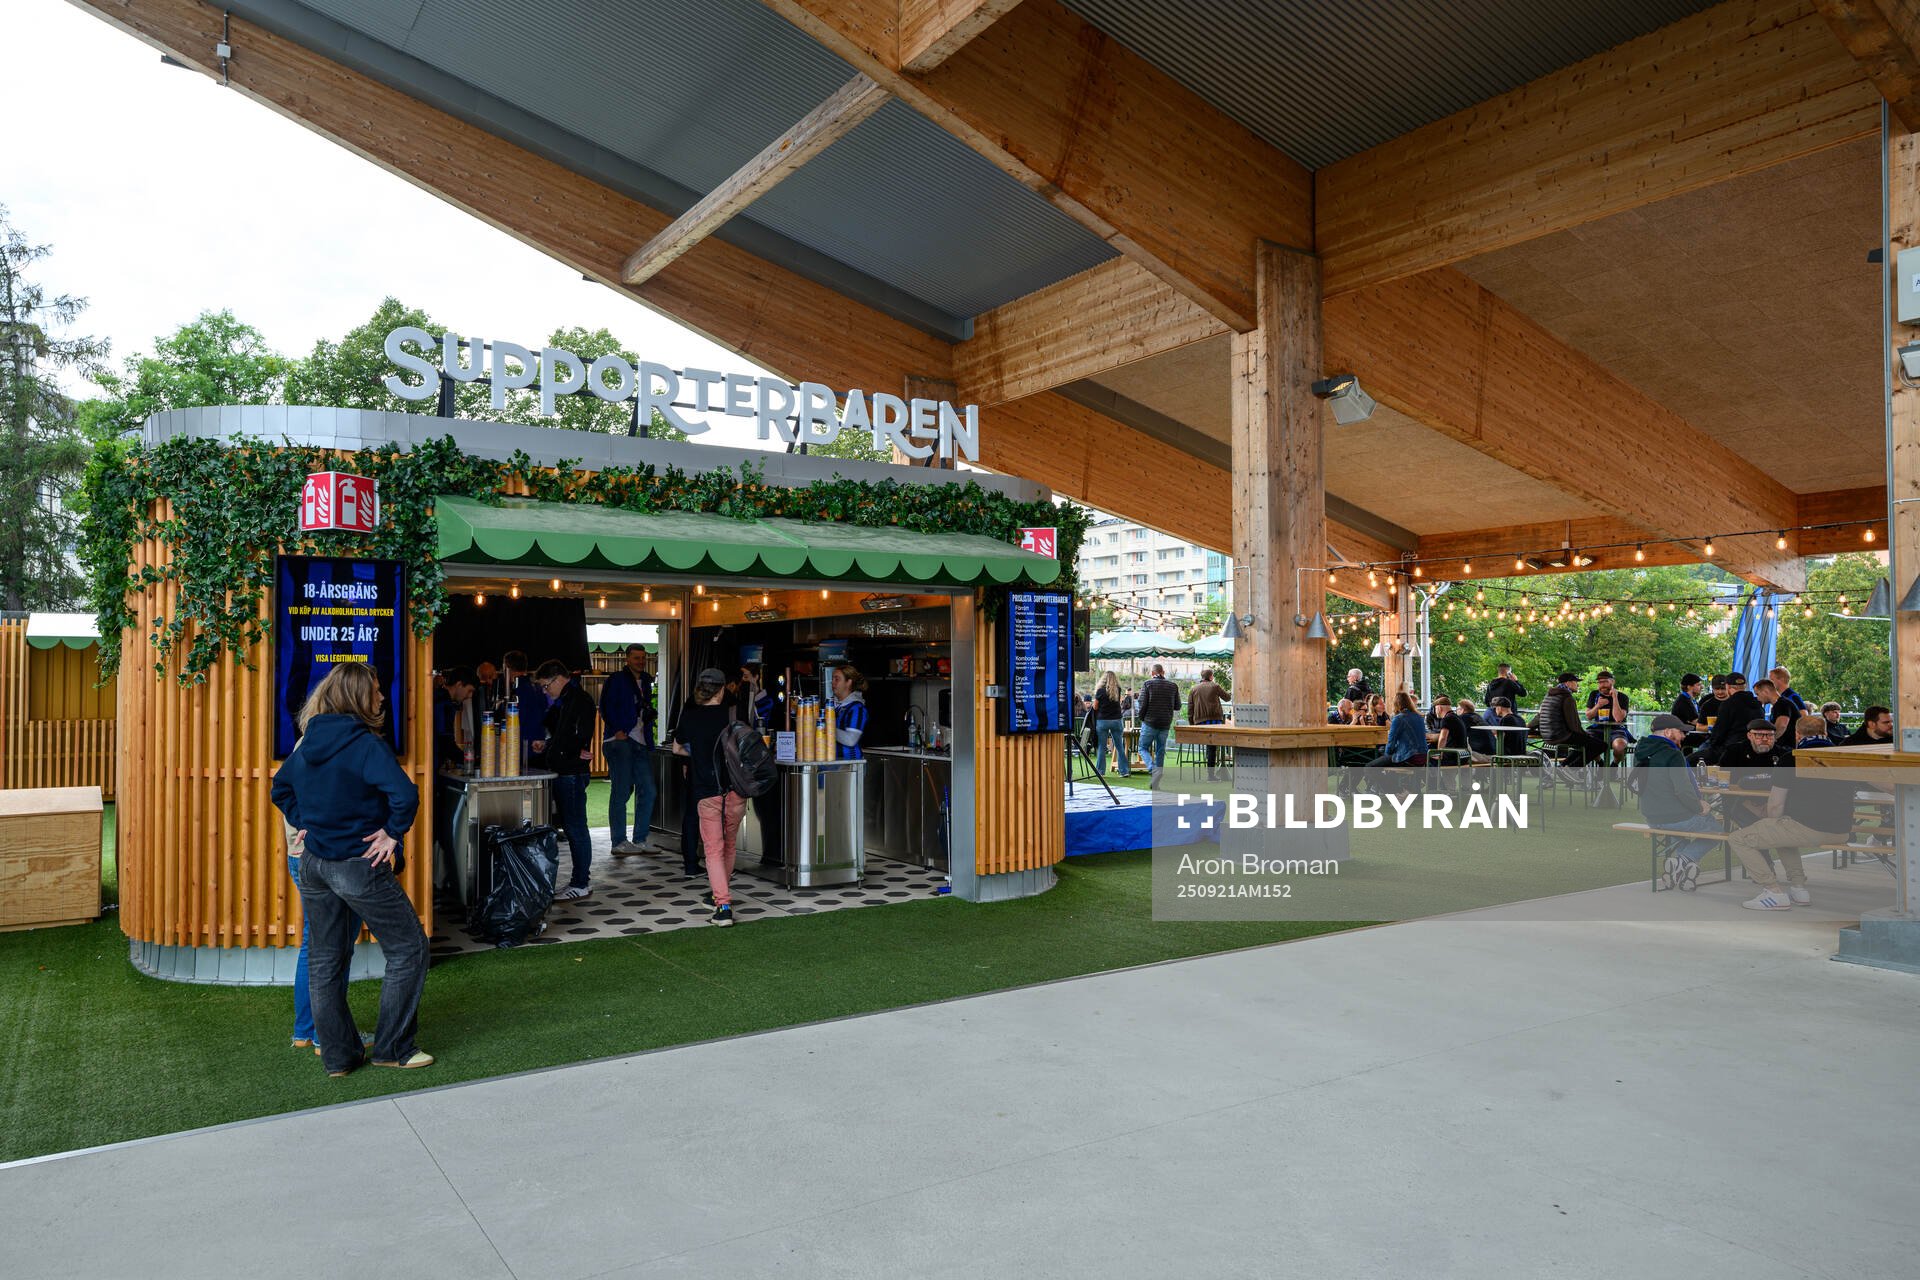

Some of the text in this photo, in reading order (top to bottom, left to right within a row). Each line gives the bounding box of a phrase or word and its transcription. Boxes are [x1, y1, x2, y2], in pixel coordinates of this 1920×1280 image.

[384, 326, 980, 462] SUPPORTERBAREN
[303, 580, 378, 600] 18-ÅRSGRÄNS
[288, 605, 394, 616] VID KÖP AV ALKOHOLHALTIGA DRYCKER
[301, 623, 379, 642] UNDER 25 ÅR?
[315, 654, 368, 663] VISA LEGITIMATION
